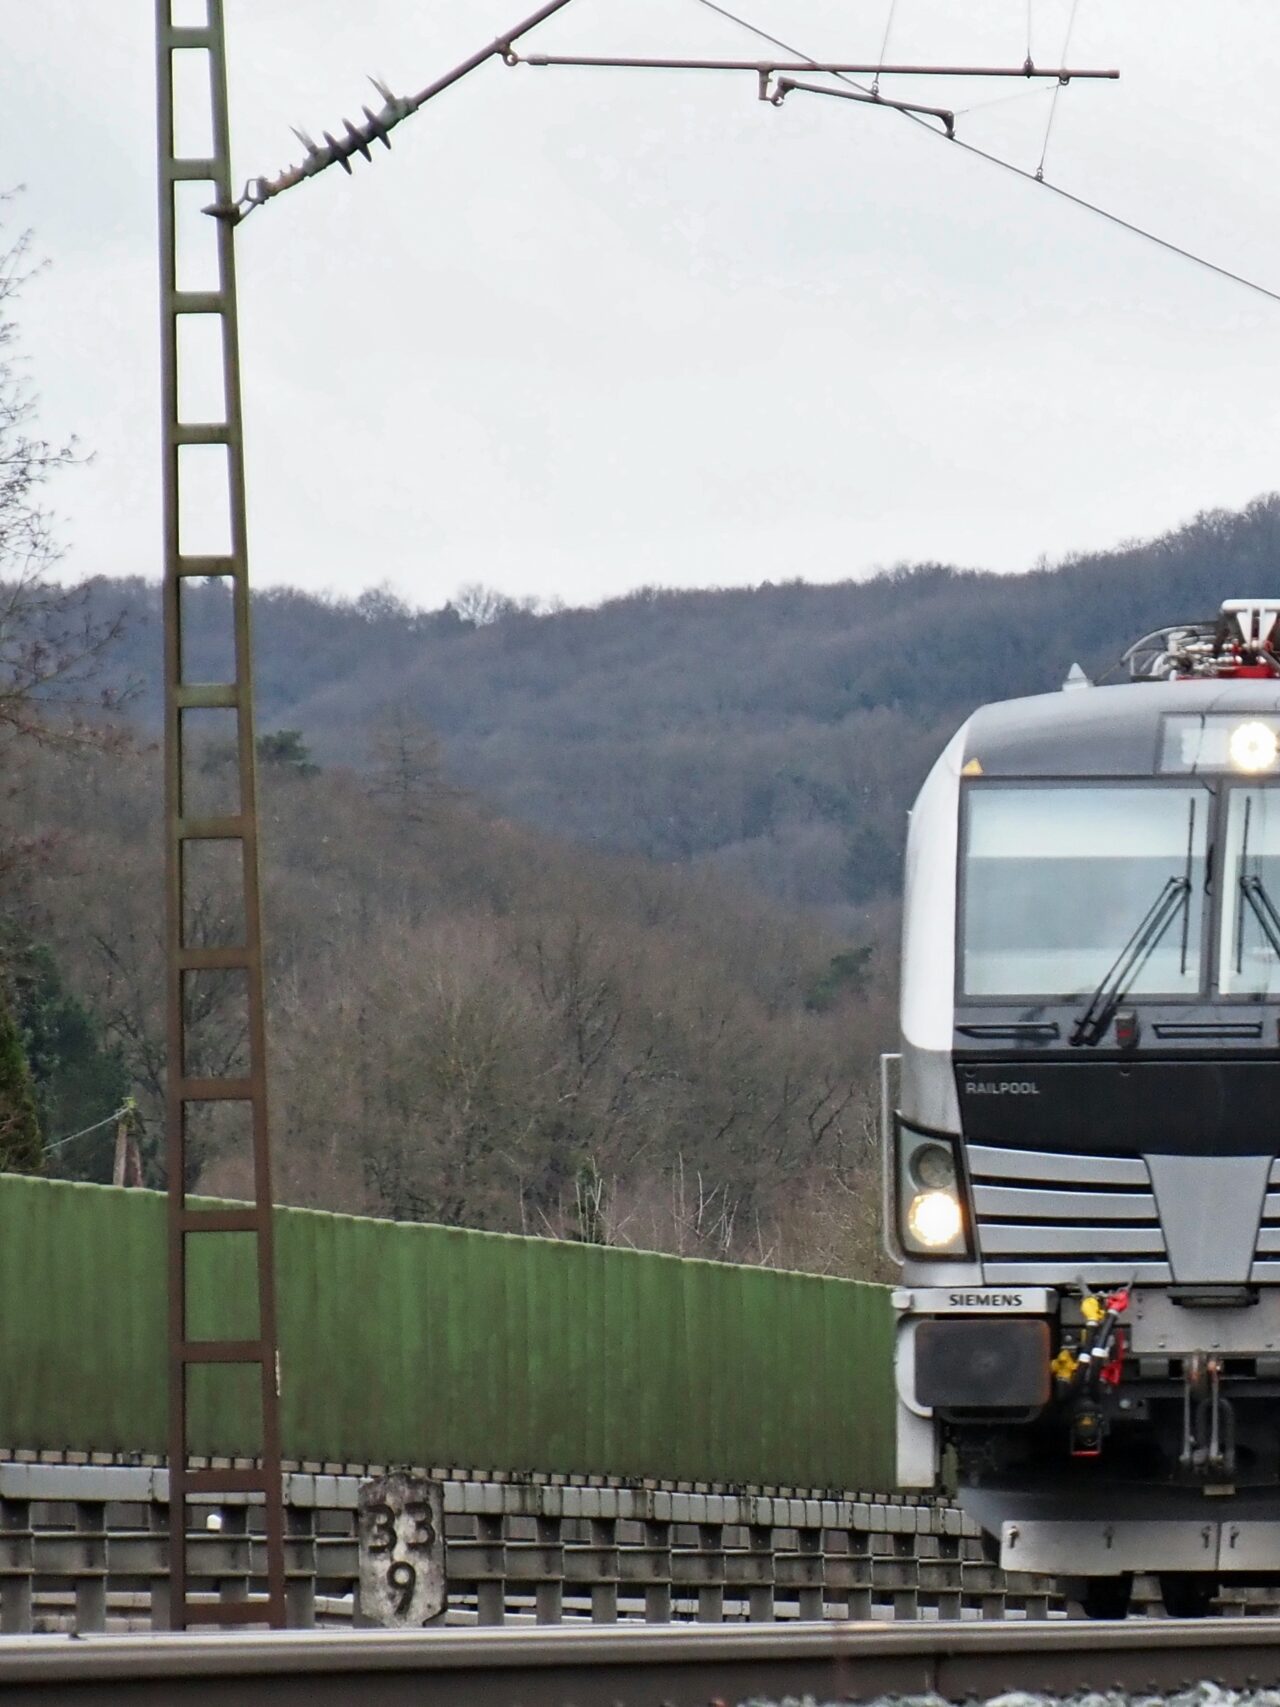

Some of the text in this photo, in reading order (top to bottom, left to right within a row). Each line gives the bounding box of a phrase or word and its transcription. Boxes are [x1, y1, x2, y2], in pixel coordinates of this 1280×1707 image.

[965, 1082, 1040, 1095] RAILPOOL
[949, 1294, 1023, 1306] SIEMENS
[367, 1502, 435, 1553] 33
[387, 1561, 416, 1617] 9
